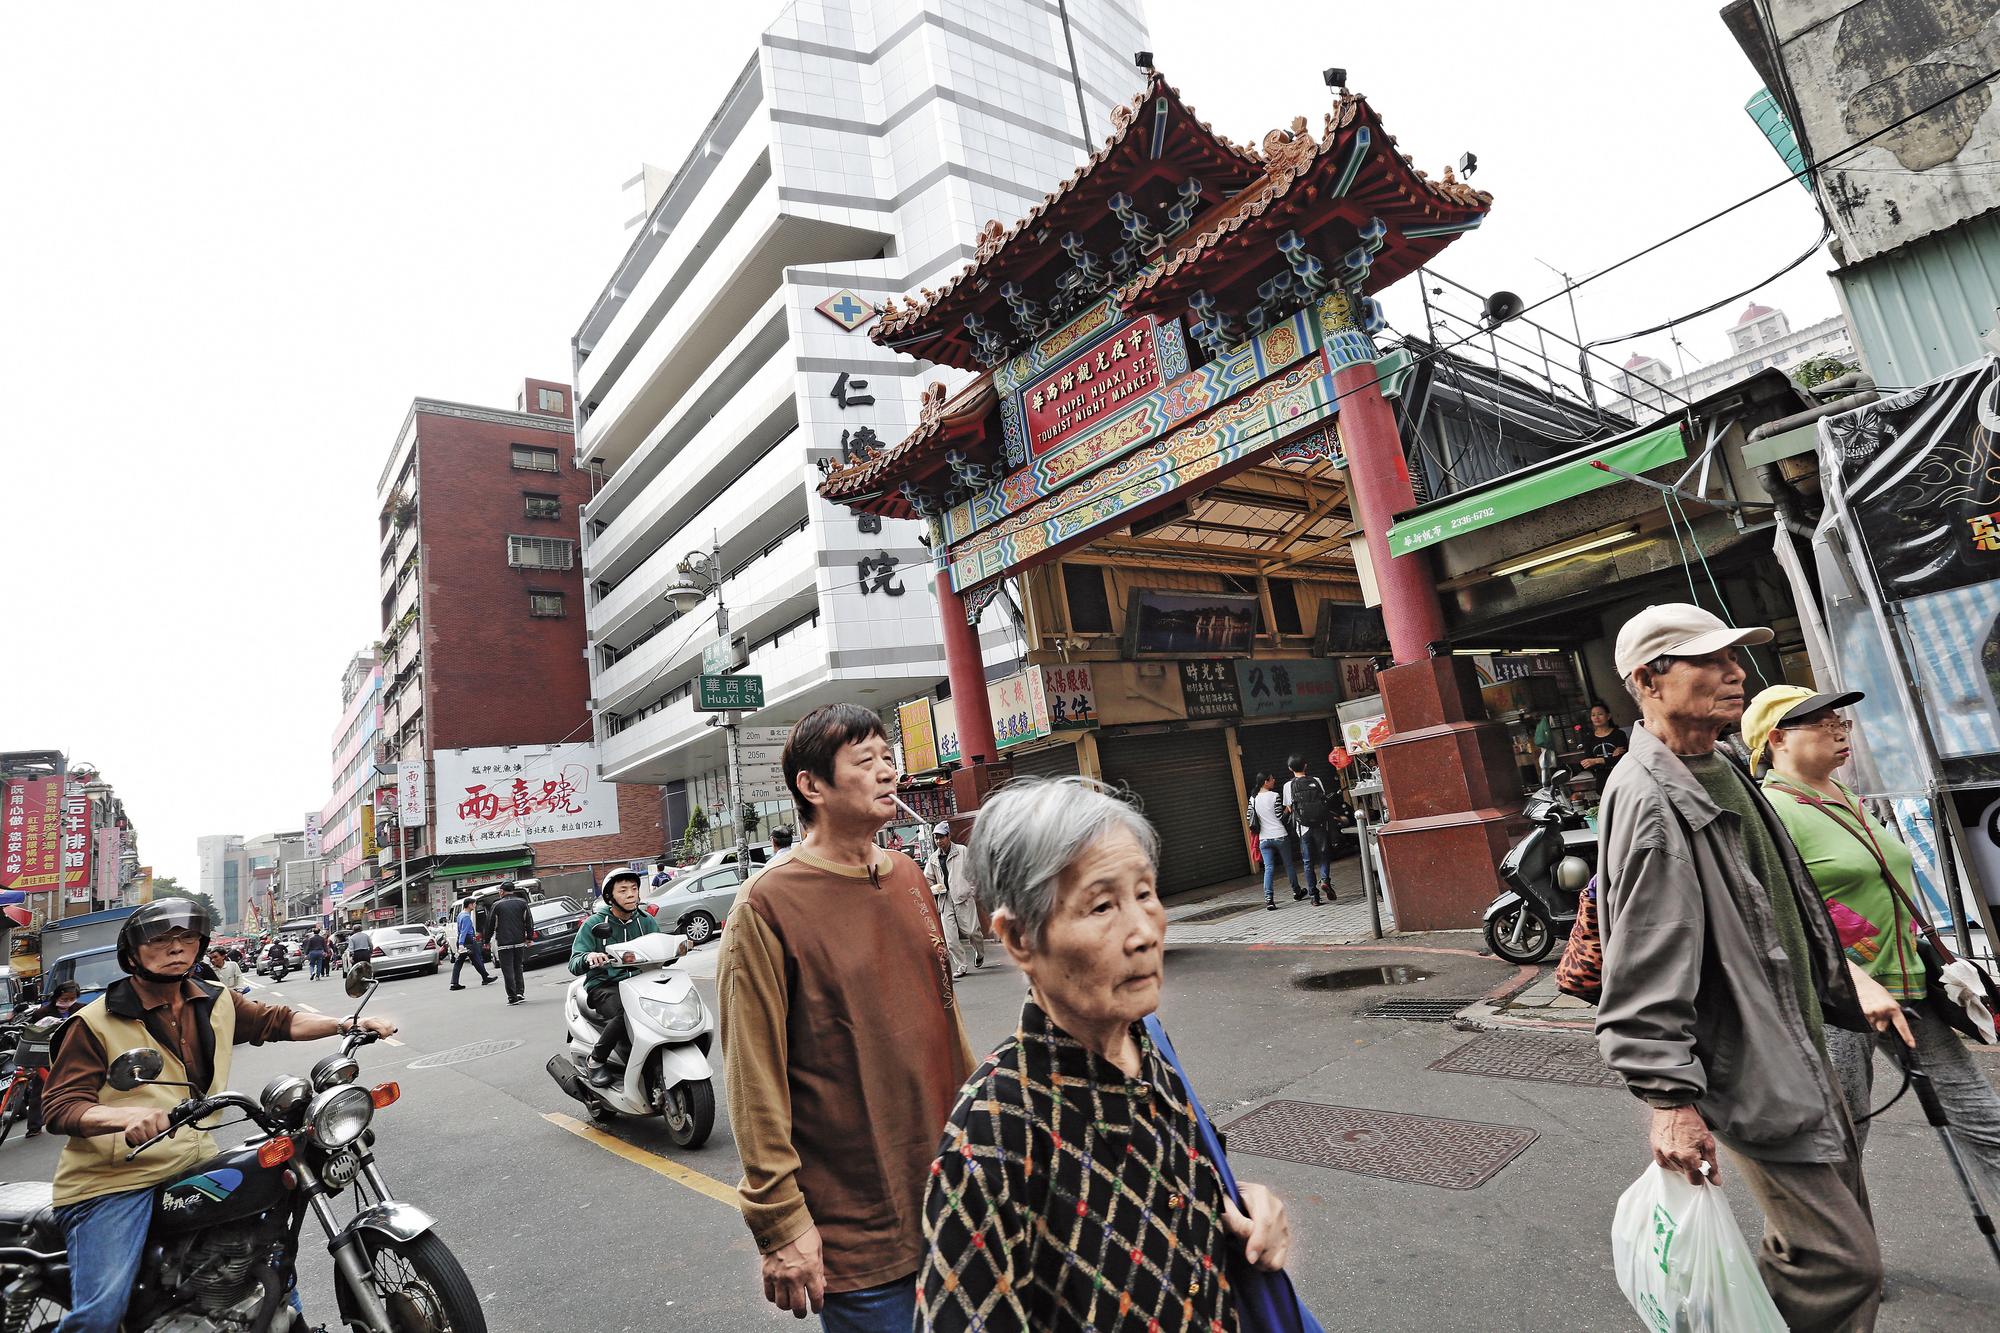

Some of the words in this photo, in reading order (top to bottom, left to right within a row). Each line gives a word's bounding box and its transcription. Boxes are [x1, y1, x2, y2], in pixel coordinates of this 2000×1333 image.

[1032, 329, 1143, 413] 華西街觀光夜市
[1056, 393, 1085, 418] TAIPEI
[1091, 369, 1126, 398] HUAXI
[1132, 357, 1149, 373] ST.
[1037, 416, 1072, 444] TOURIST
[1075, 397, 1106, 422] NIGHT
[1111, 370, 1153, 402] MARKET
[1451, 507, 1495, 529] 2336-6792
[1045, 668, 1091, 694] 太陽眼鏡
[1186, 663, 1225, 681] 時光堂
[706, 678, 757, 693] 華西街
[707, 694, 739, 704] HuaXi
[745, 694, 758, 704] St.
[1053, 694, 1093, 726] 皮件
[746, 731, 761, 740] 20m
[748, 751, 765, 759] 205m
[405, 770, 421, 814] 兩喜號
[458, 772, 583, 821] 兩喜號
[752, 789, 770, 798] 470m
[65, 781, 87, 868] 皇后牛排館
